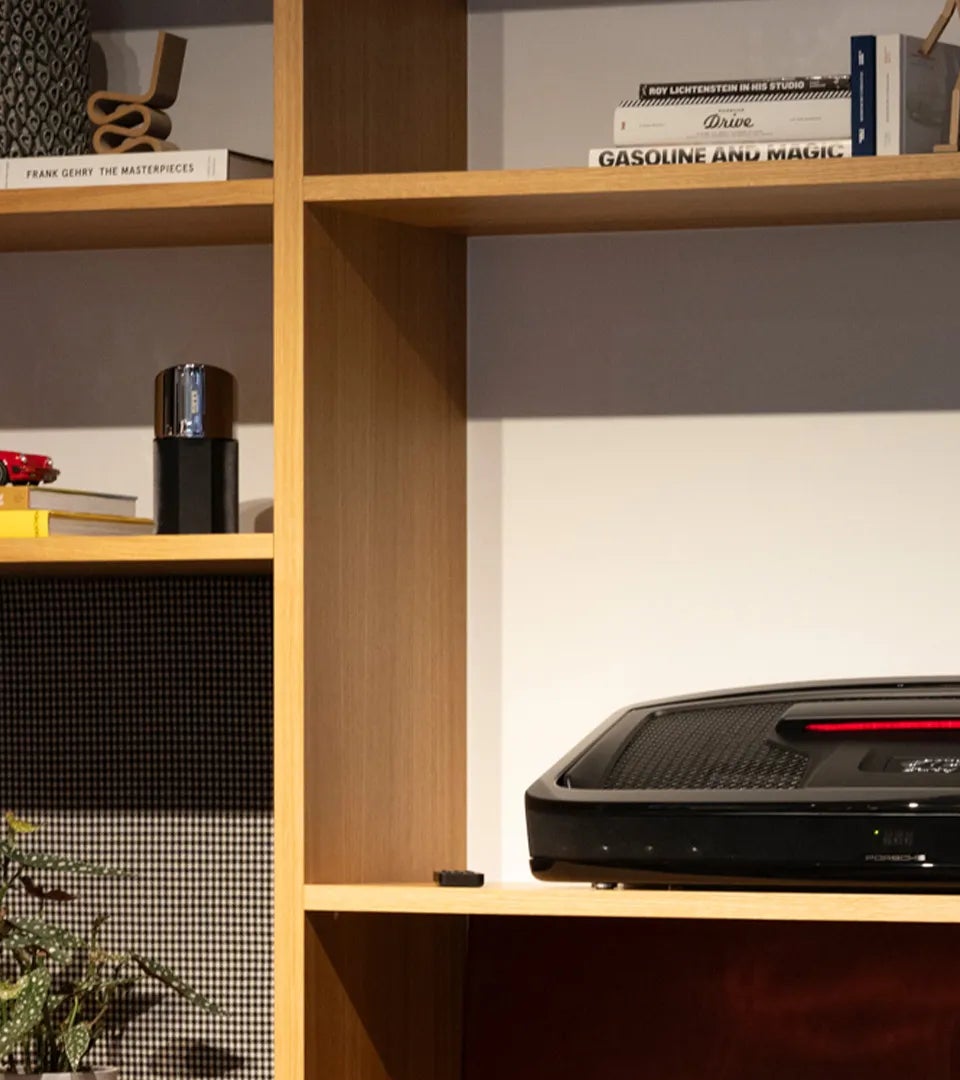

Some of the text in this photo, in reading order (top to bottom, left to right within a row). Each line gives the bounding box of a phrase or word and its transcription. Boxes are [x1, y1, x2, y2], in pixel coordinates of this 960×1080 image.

[649, 86, 669, 95] ROY
[669, 83, 738, 95] LICHTENSTEIN
[740, 82, 750, 92] IN
[751, 81, 768, 92] HIS
[769, 80, 805, 91] STUDIO
[703, 112, 754, 130] Drive
[598, 143, 844, 168] GASOLINE AND MAGIC
[26, 168, 59, 179] FRANK
[62, 167, 94, 178] GEHRY
[99, 166, 118, 177] THE
[121, 163, 195, 176] MASTERPIECES
